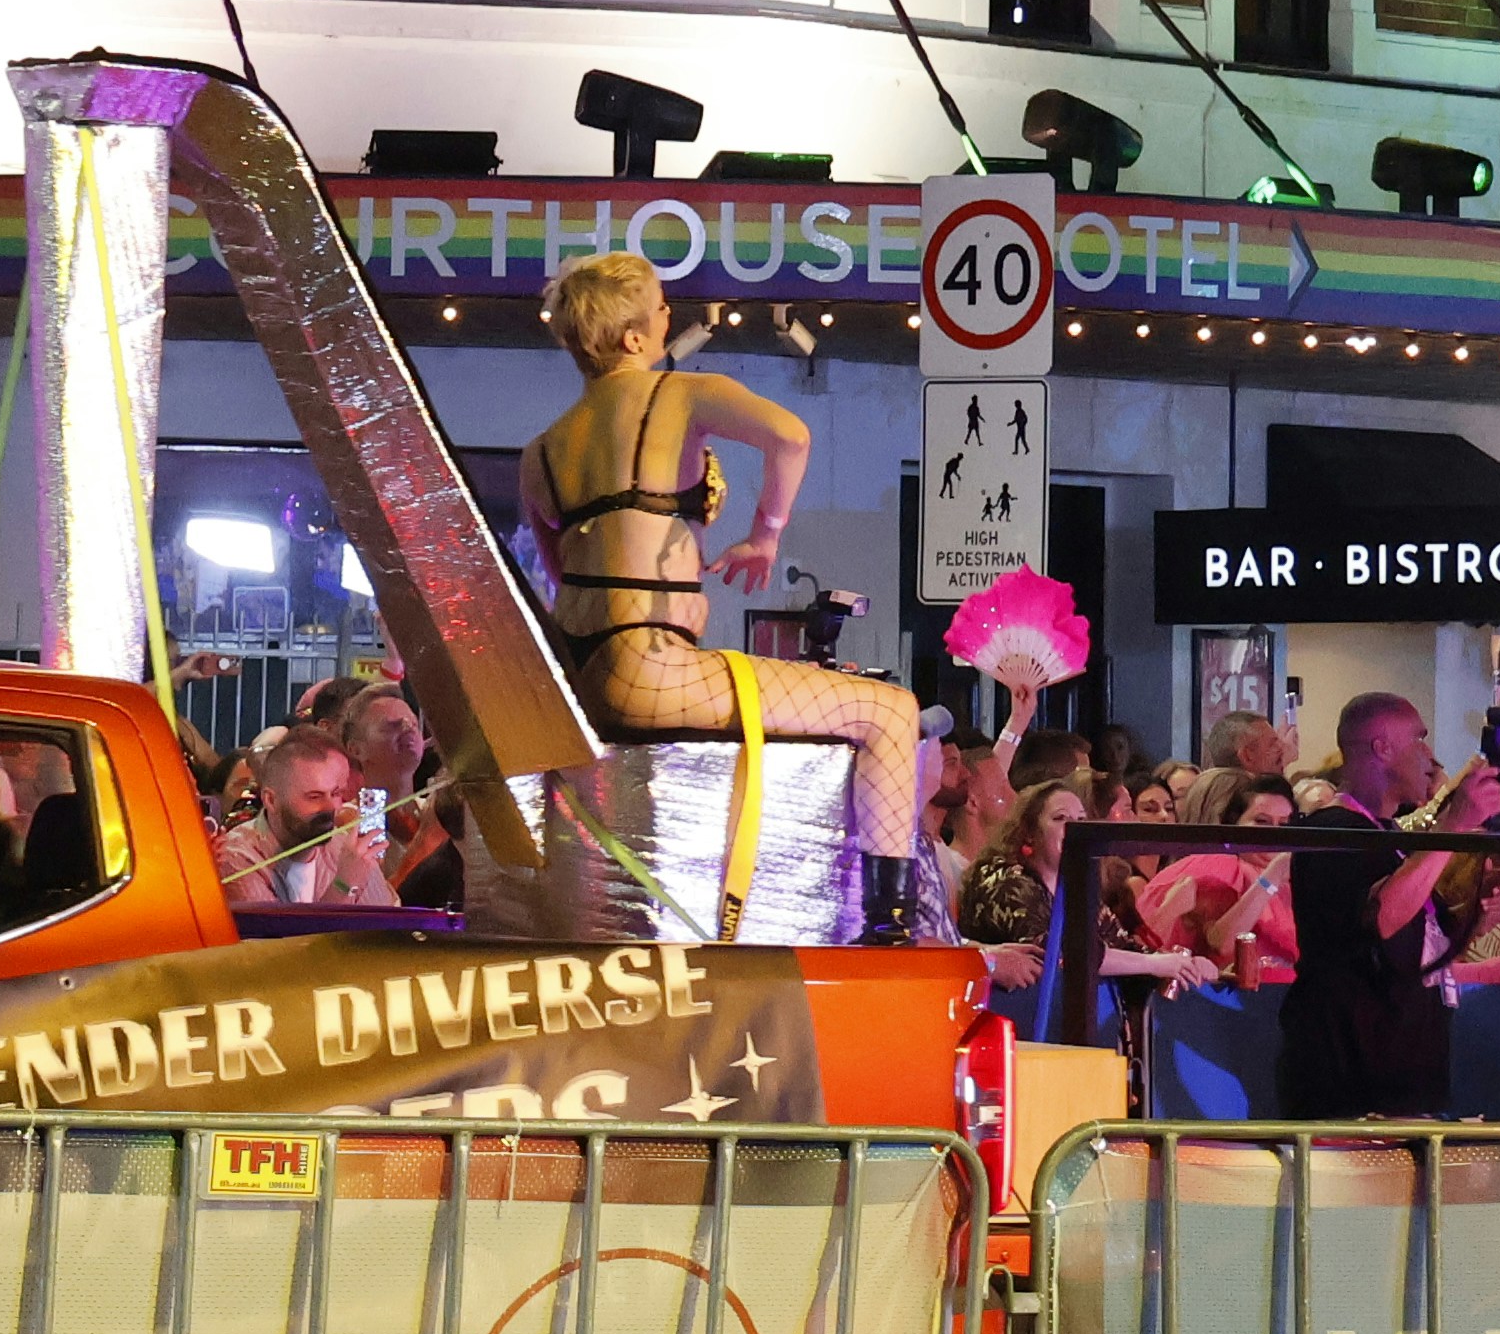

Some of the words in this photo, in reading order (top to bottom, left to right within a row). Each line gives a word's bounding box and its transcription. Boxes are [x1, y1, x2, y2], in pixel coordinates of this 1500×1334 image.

[942, 243, 1031, 305] 40
[1059, 211, 1261, 301] OTEL
[964, 530, 999, 546] HIGH
[935, 551, 1027, 567] PEDESTRIAN
[1205, 546, 1296, 587] BAR
[1210, 674, 1259, 712] $15
[312, 945, 715, 1067] DIVERSE
[224, 1140, 300, 1175] TFH
